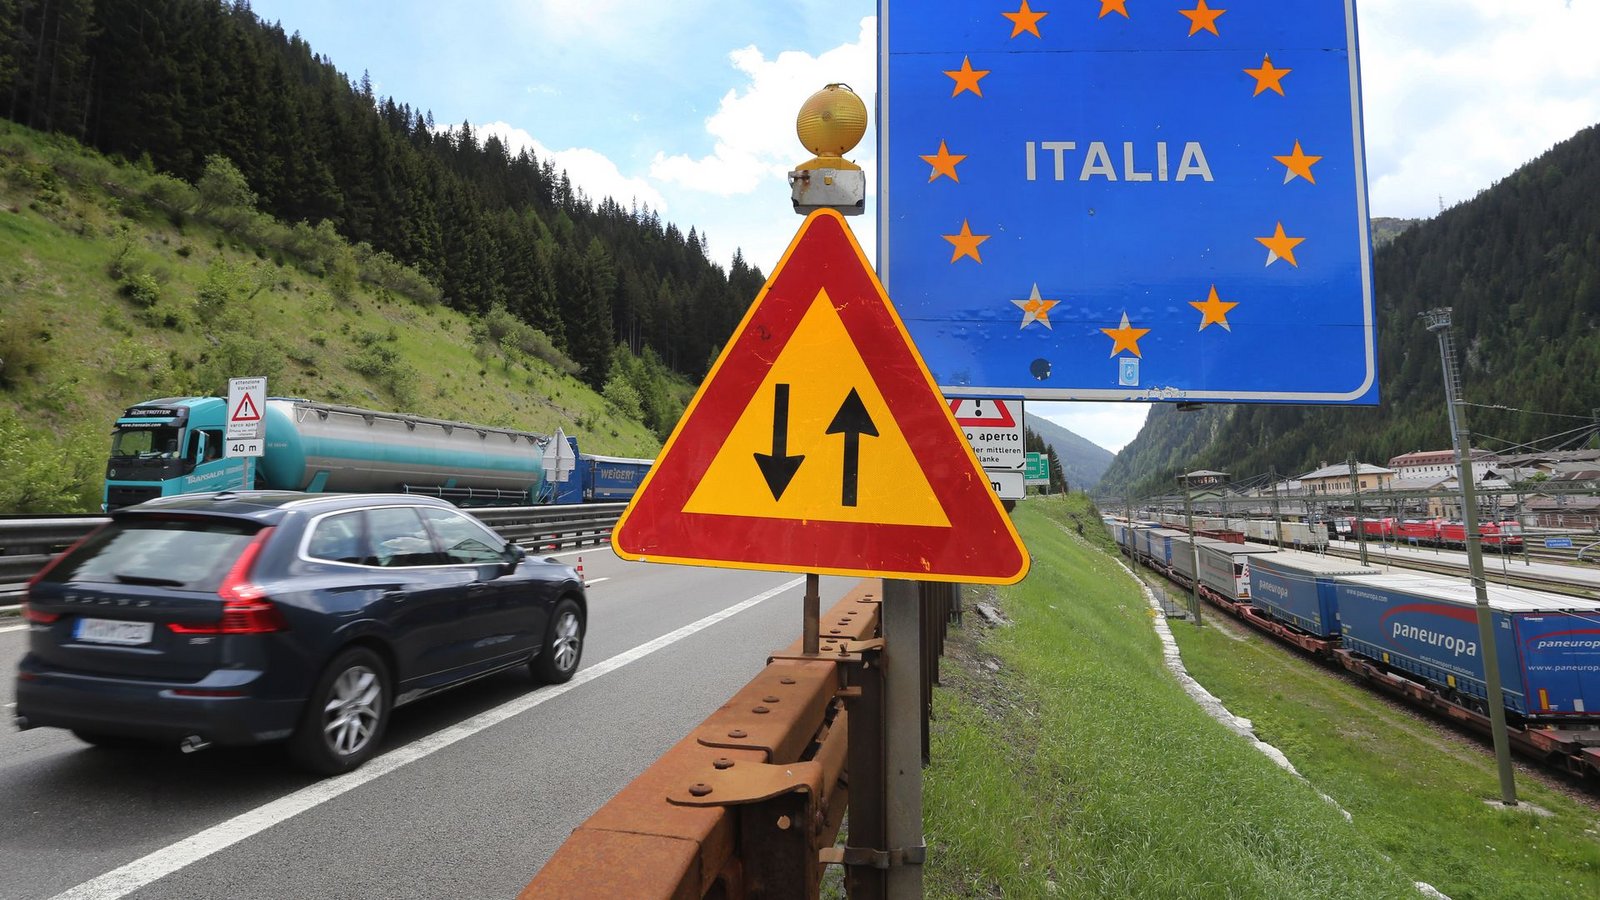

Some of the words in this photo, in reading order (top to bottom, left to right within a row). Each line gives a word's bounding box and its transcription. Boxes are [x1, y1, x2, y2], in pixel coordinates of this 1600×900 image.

[1026, 141, 1214, 181] ITALIA
[979, 433, 1019, 442] aperto
[232, 444, 245, 452] 40
[1259, 580, 1288, 599] paneuropa
[1392, 622, 1477, 657] paneuropa
[1537, 640, 1600, 649] paneurop
